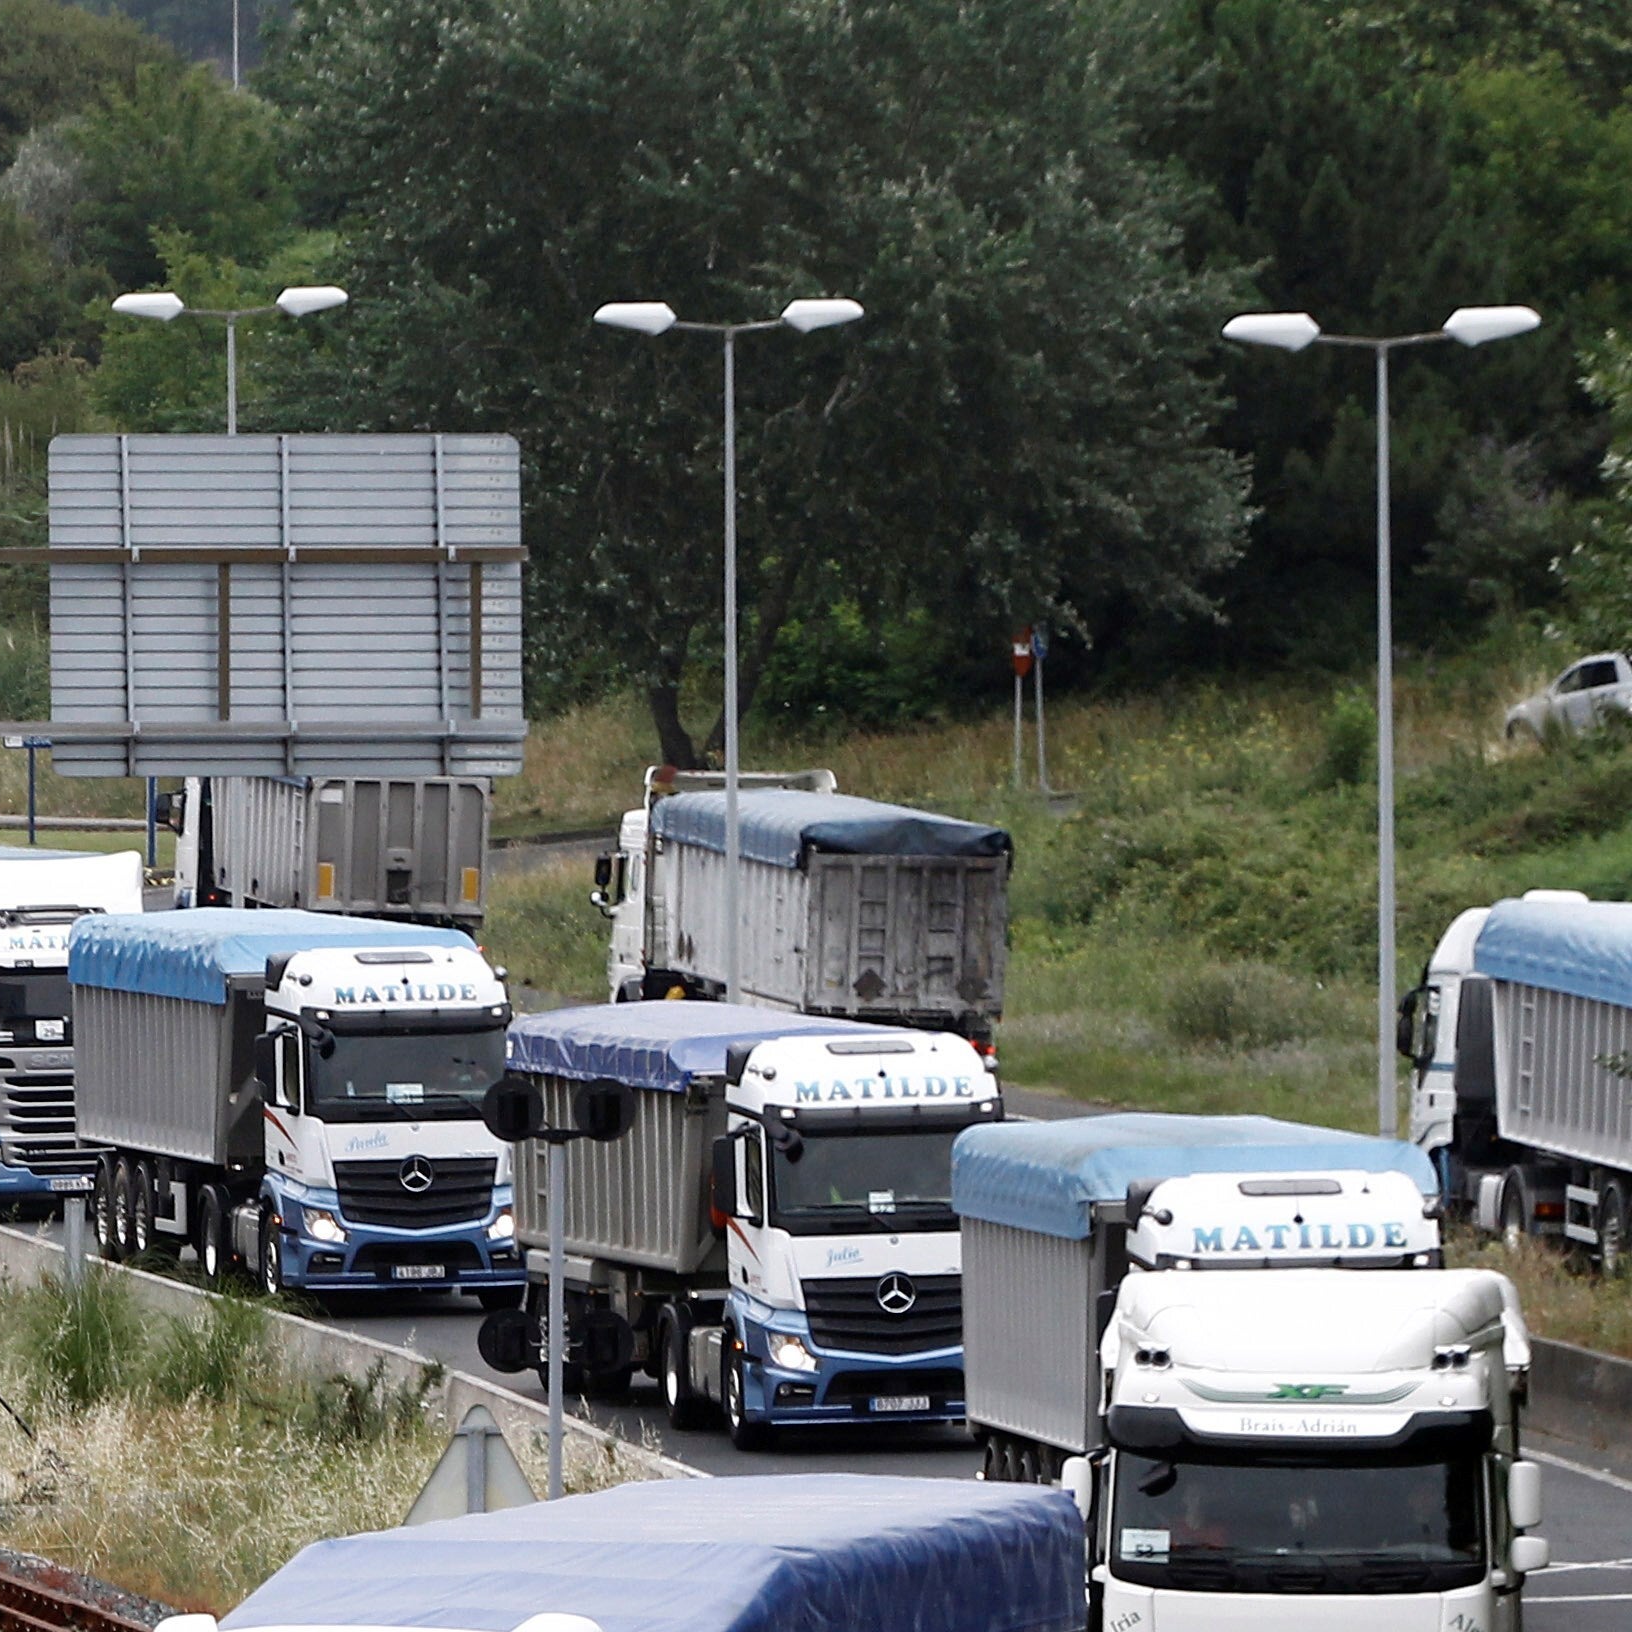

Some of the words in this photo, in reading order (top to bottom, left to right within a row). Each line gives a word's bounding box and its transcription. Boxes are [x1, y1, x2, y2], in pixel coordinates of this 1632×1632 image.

[334, 983, 478, 1005] MATILDE
[794, 1076, 974, 1103] MATILDE
[1192, 1221, 1408, 1253] MATILDE
[825, 1246, 863, 1268] Julio
[1266, 1382, 1350, 1400] XF
